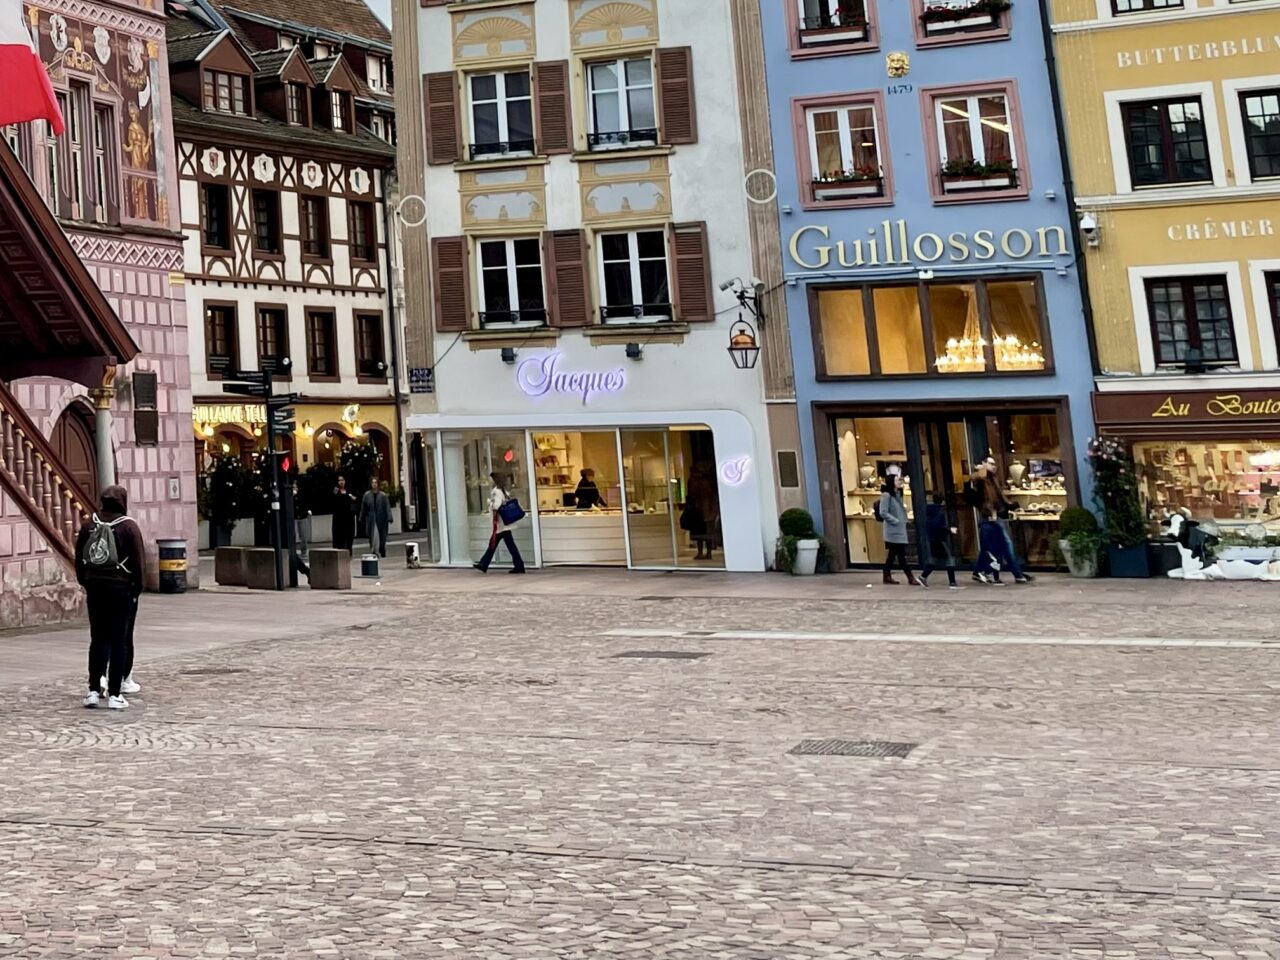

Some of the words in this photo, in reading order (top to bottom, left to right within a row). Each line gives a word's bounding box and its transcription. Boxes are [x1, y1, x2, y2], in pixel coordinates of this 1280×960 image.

[887, 84, 913, 95] 1479
[788, 218, 1071, 269] Guillosson
[516, 351, 625, 406] Jacques
[245, 404, 267, 423] TELL
[1151, 395, 1191, 417] Au
